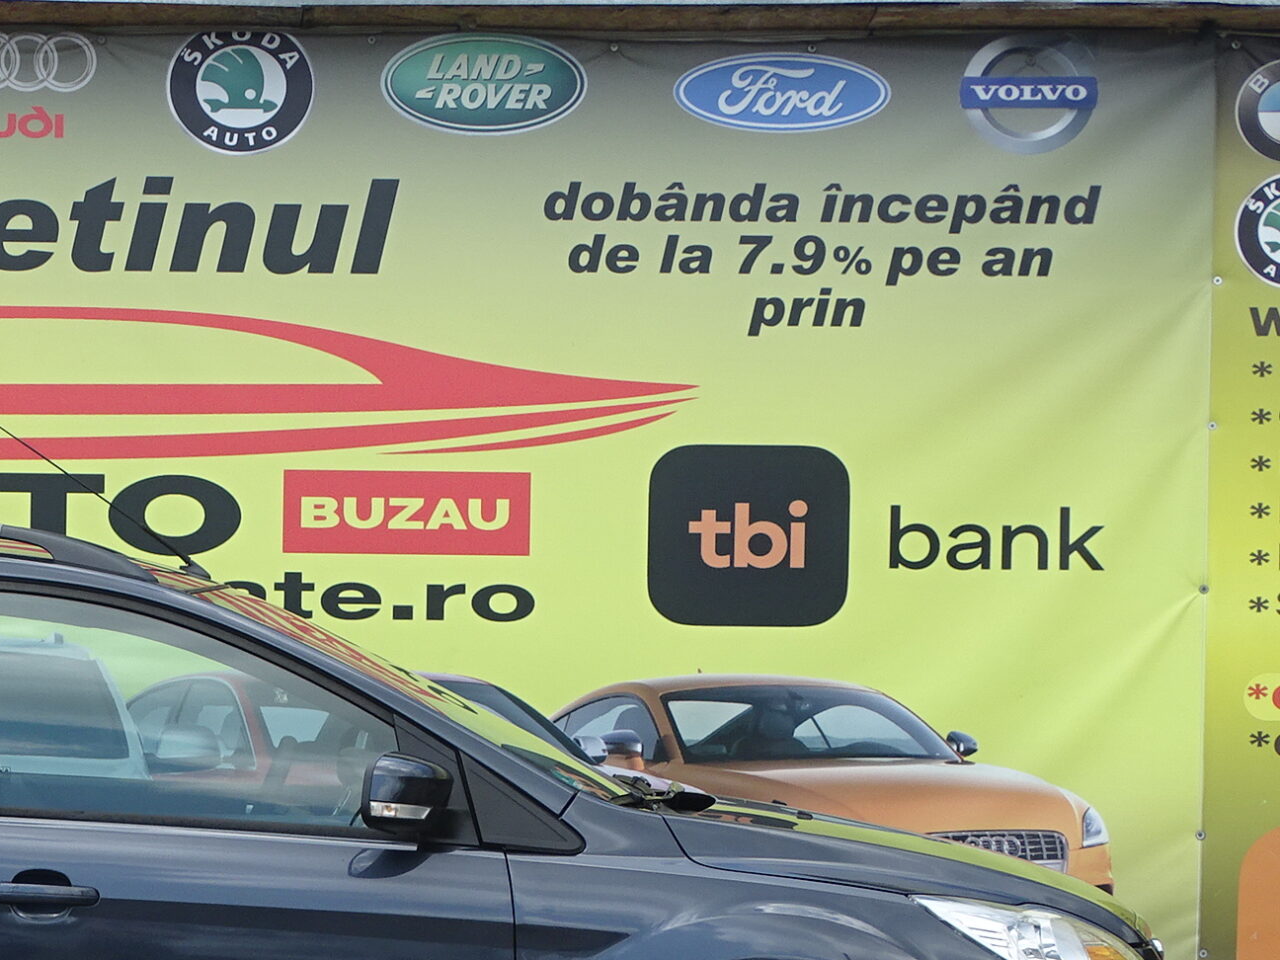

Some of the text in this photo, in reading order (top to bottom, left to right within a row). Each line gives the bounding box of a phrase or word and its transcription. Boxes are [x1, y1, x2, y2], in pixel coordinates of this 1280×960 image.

[426, 53, 521, 81] LAND
[434, 83, 552, 110] ROVER
[717, 65, 845, 117] Ford
[971, 85, 1088, 101] VOLVO
[203, 126, 277, 146] AUTO
[543, 182, 1102, 234] dobânda începând
[568, 234, 1054, 286] de la 7.9% pe an
[748, 288, 866, 337] prin
[300, 496, 510, 530] BUZAU
[688, 500, 1106, 572] tbi bank
